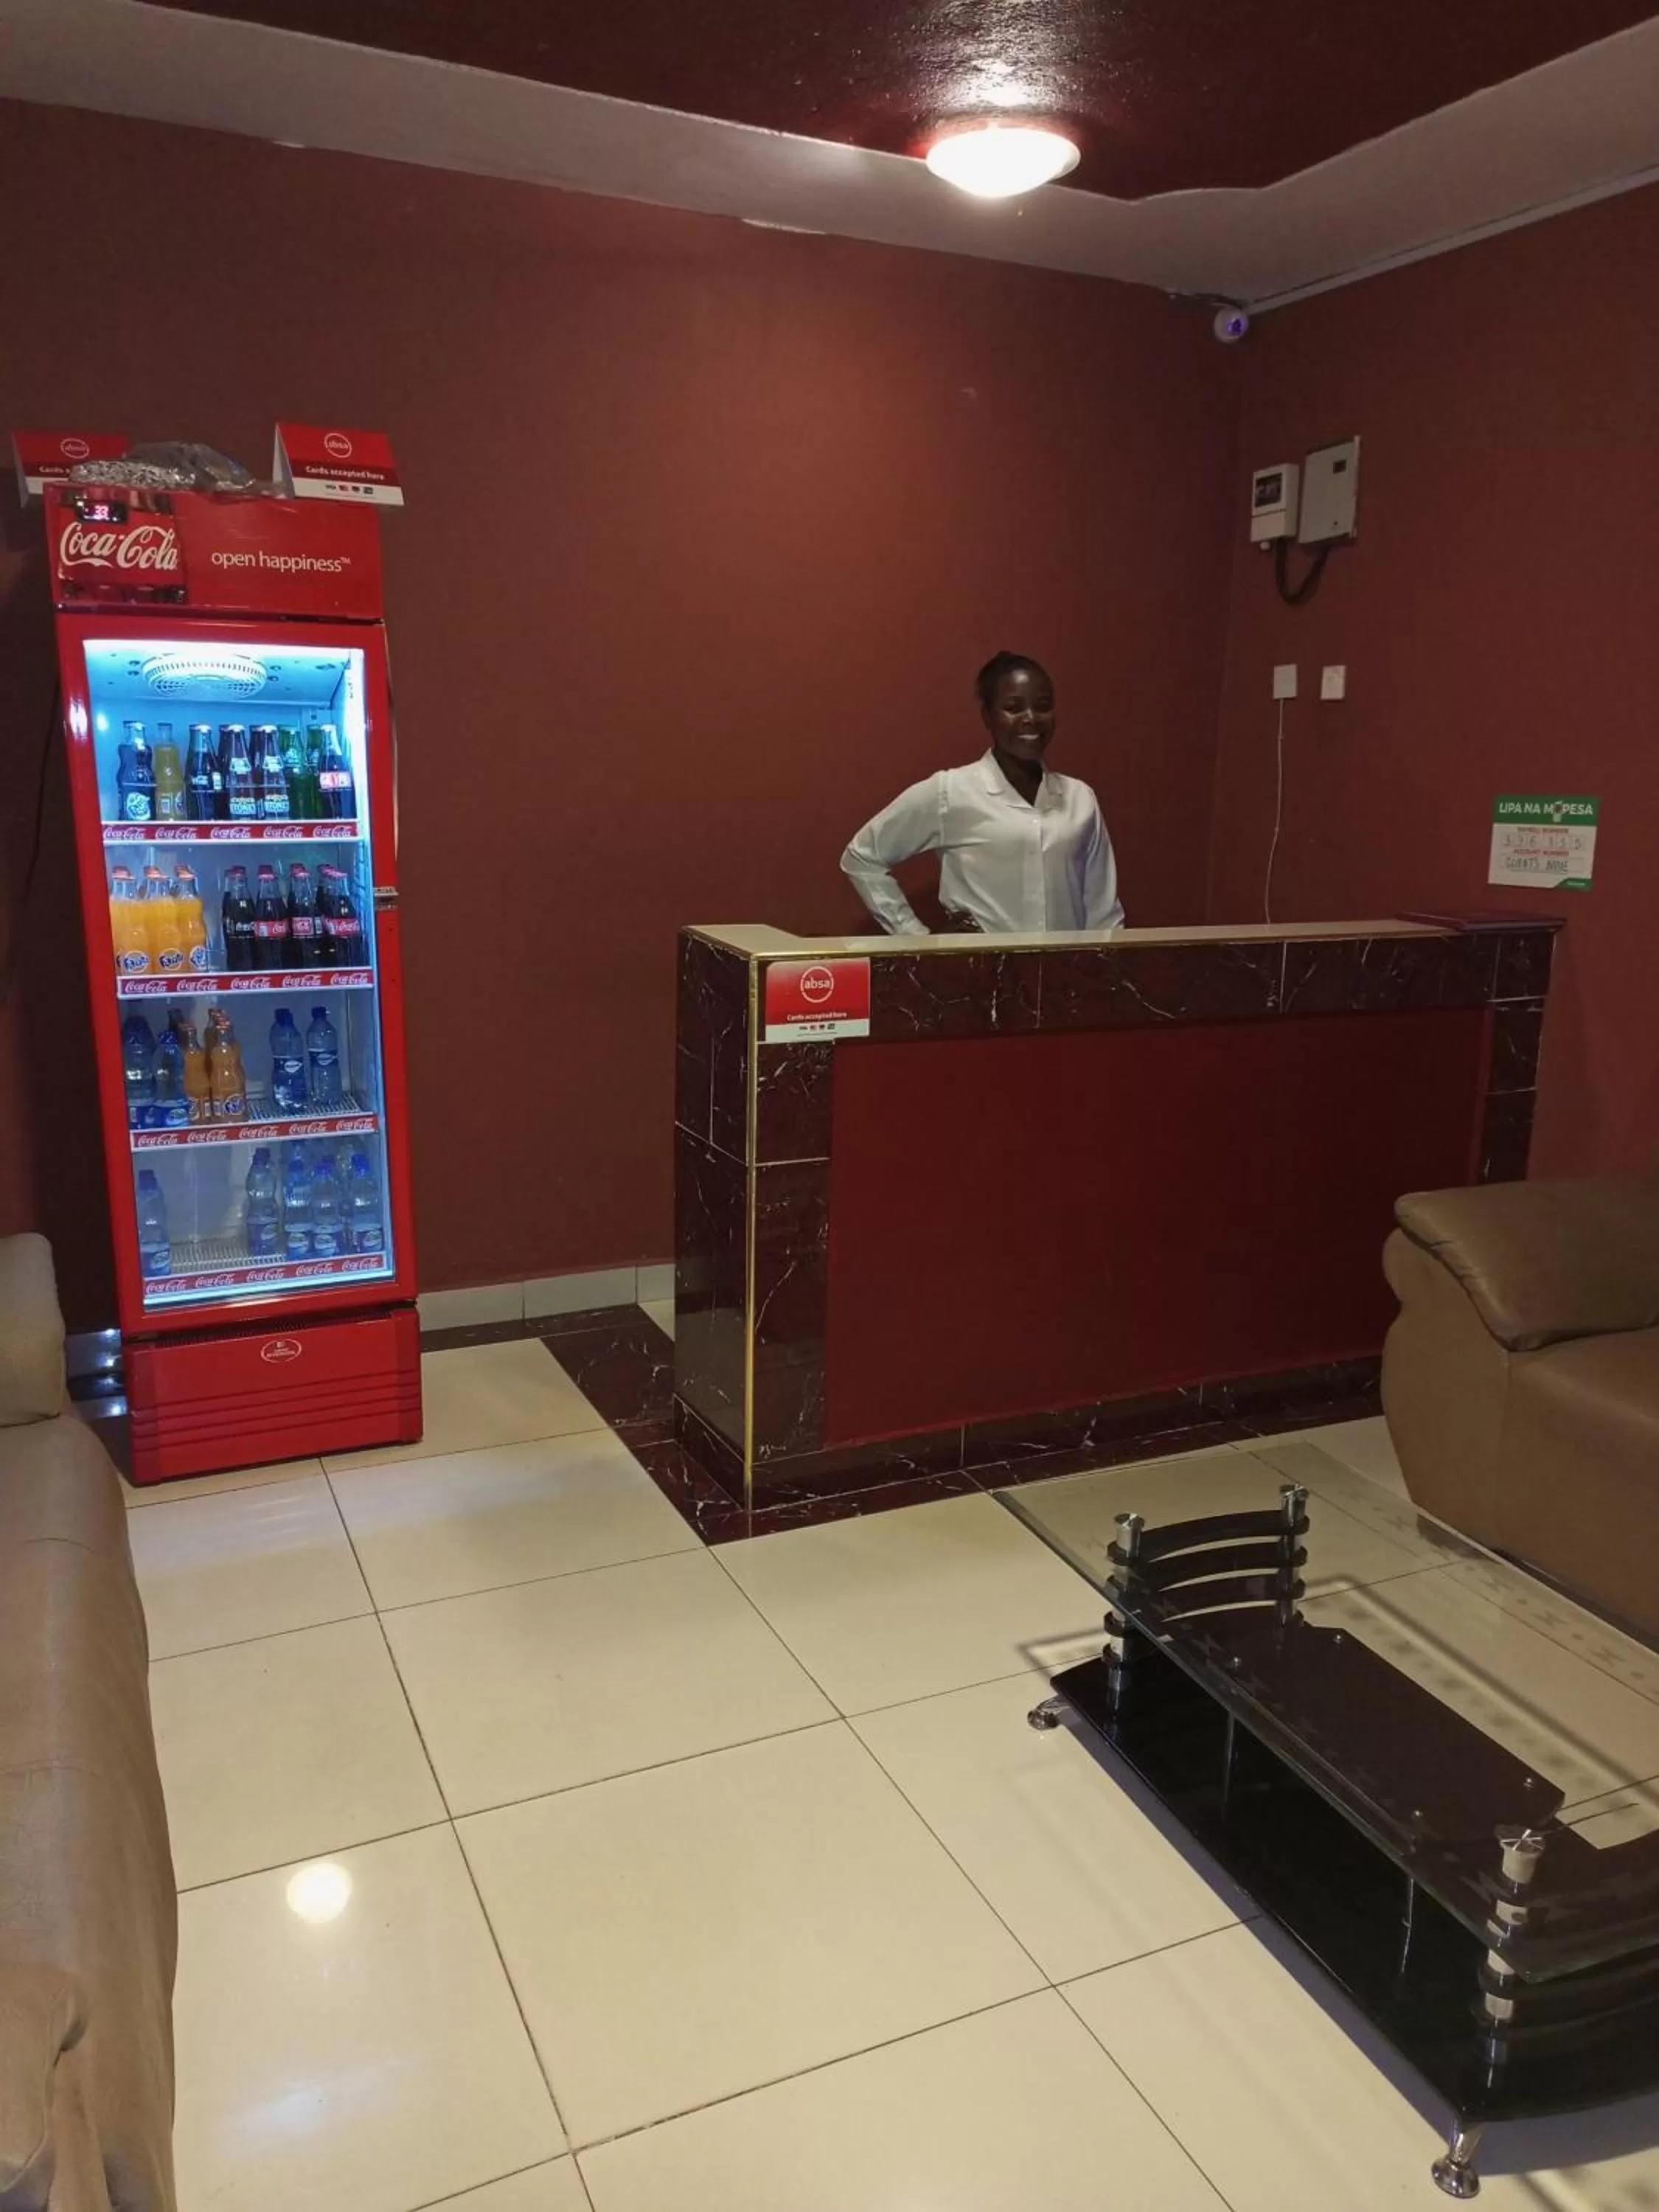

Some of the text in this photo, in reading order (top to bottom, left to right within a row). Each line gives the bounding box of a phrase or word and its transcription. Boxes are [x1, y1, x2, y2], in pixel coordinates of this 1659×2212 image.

[60, 521, 178, 570] Coca-Cola
[212, 552, 256, 569] open
[804, 977, 830, 990] absa
[787, 1013, 804, 1021] Cards
[805, 1012, 832, 1020] accepted
